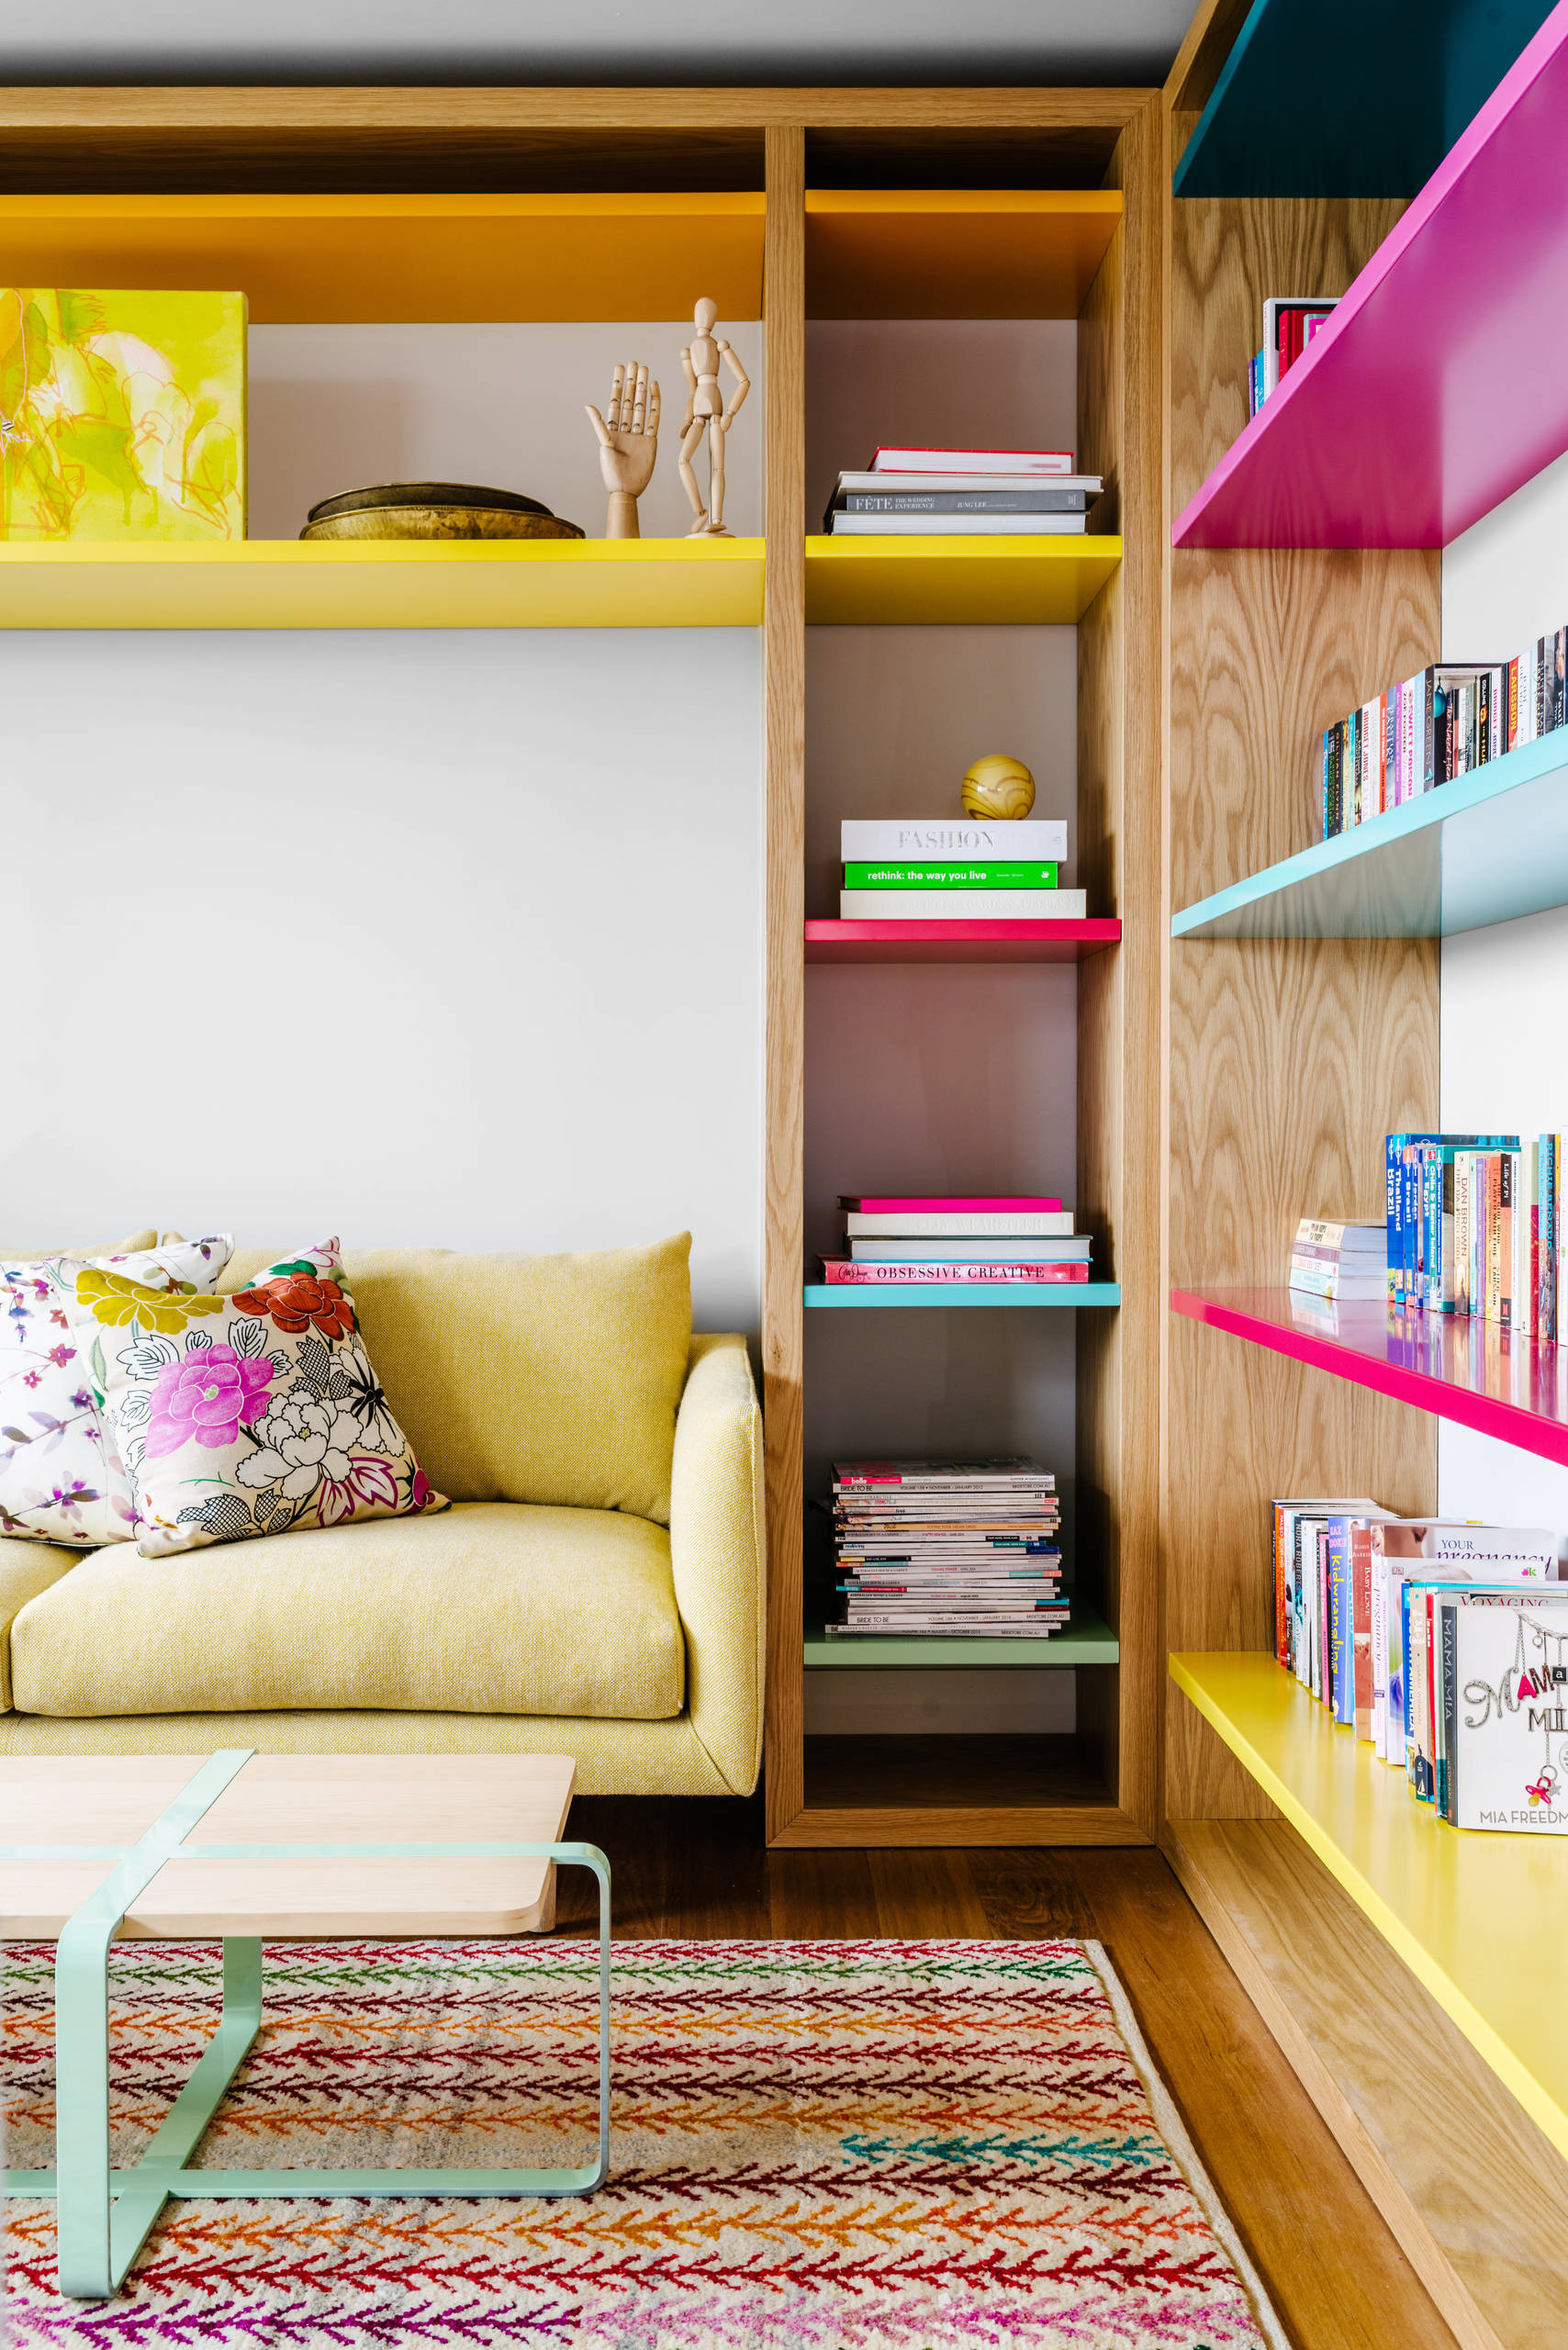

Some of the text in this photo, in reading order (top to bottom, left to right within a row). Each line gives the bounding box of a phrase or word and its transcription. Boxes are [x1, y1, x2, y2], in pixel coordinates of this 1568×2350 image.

[856, 495, 893, 509] FÊTE
[1509, 665, 1518, 732] LARSSON
[1425, 678, 1433, 766] JANE GREEN
[898, 830, 995, 849] FASHION
[867, 870, 987, 882] rethink: the way you live
[1387, 1168, 1395, 1216] Brazil
[1461, 1176, 1469, 1205] DAN
[1502, 1181, 1510, 1192] of
[877, 1267, 961, 1279] OBSESSIVE
[968, 1266, 1045, 1279] CREATIVE
[851, 1476, 868, 1484] belle
[1440, 1539, 1474, 1550] YOUR
[1331, 1554, 1346, 1675] kidwrangling
[1443, 1618, 1454, 1720] MAMA MIA
[1479, 1810, 1507, 1824] MIA
